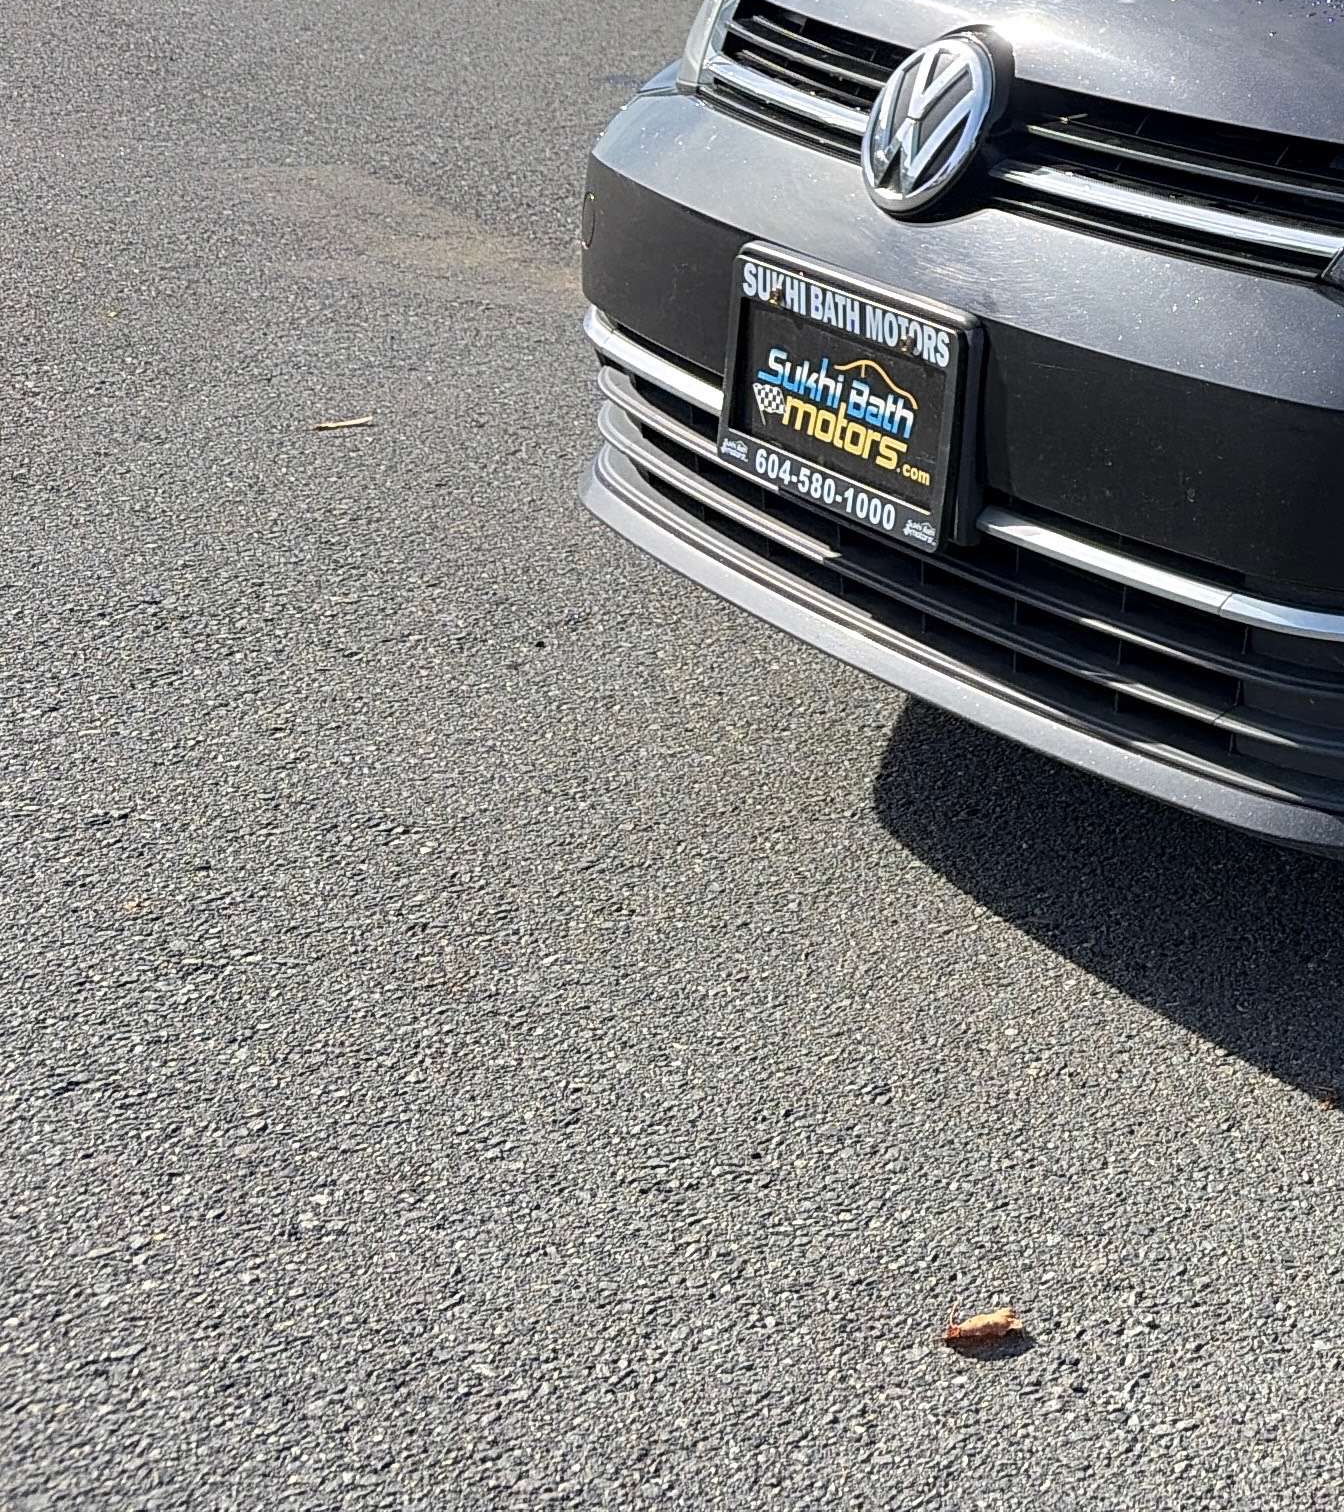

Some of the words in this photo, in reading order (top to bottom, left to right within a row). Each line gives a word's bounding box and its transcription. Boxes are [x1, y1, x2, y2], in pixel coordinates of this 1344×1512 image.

[743, 262, 807, 315] SUKHI
[810, 285, 861, 335] BATH
[865, 305, 950, 368] MOTORS
[757, 348, 845, 409] Sukhi
[846, 379, 915, 439] Bath
[755, 448, 896, 530] 604-580-1000
